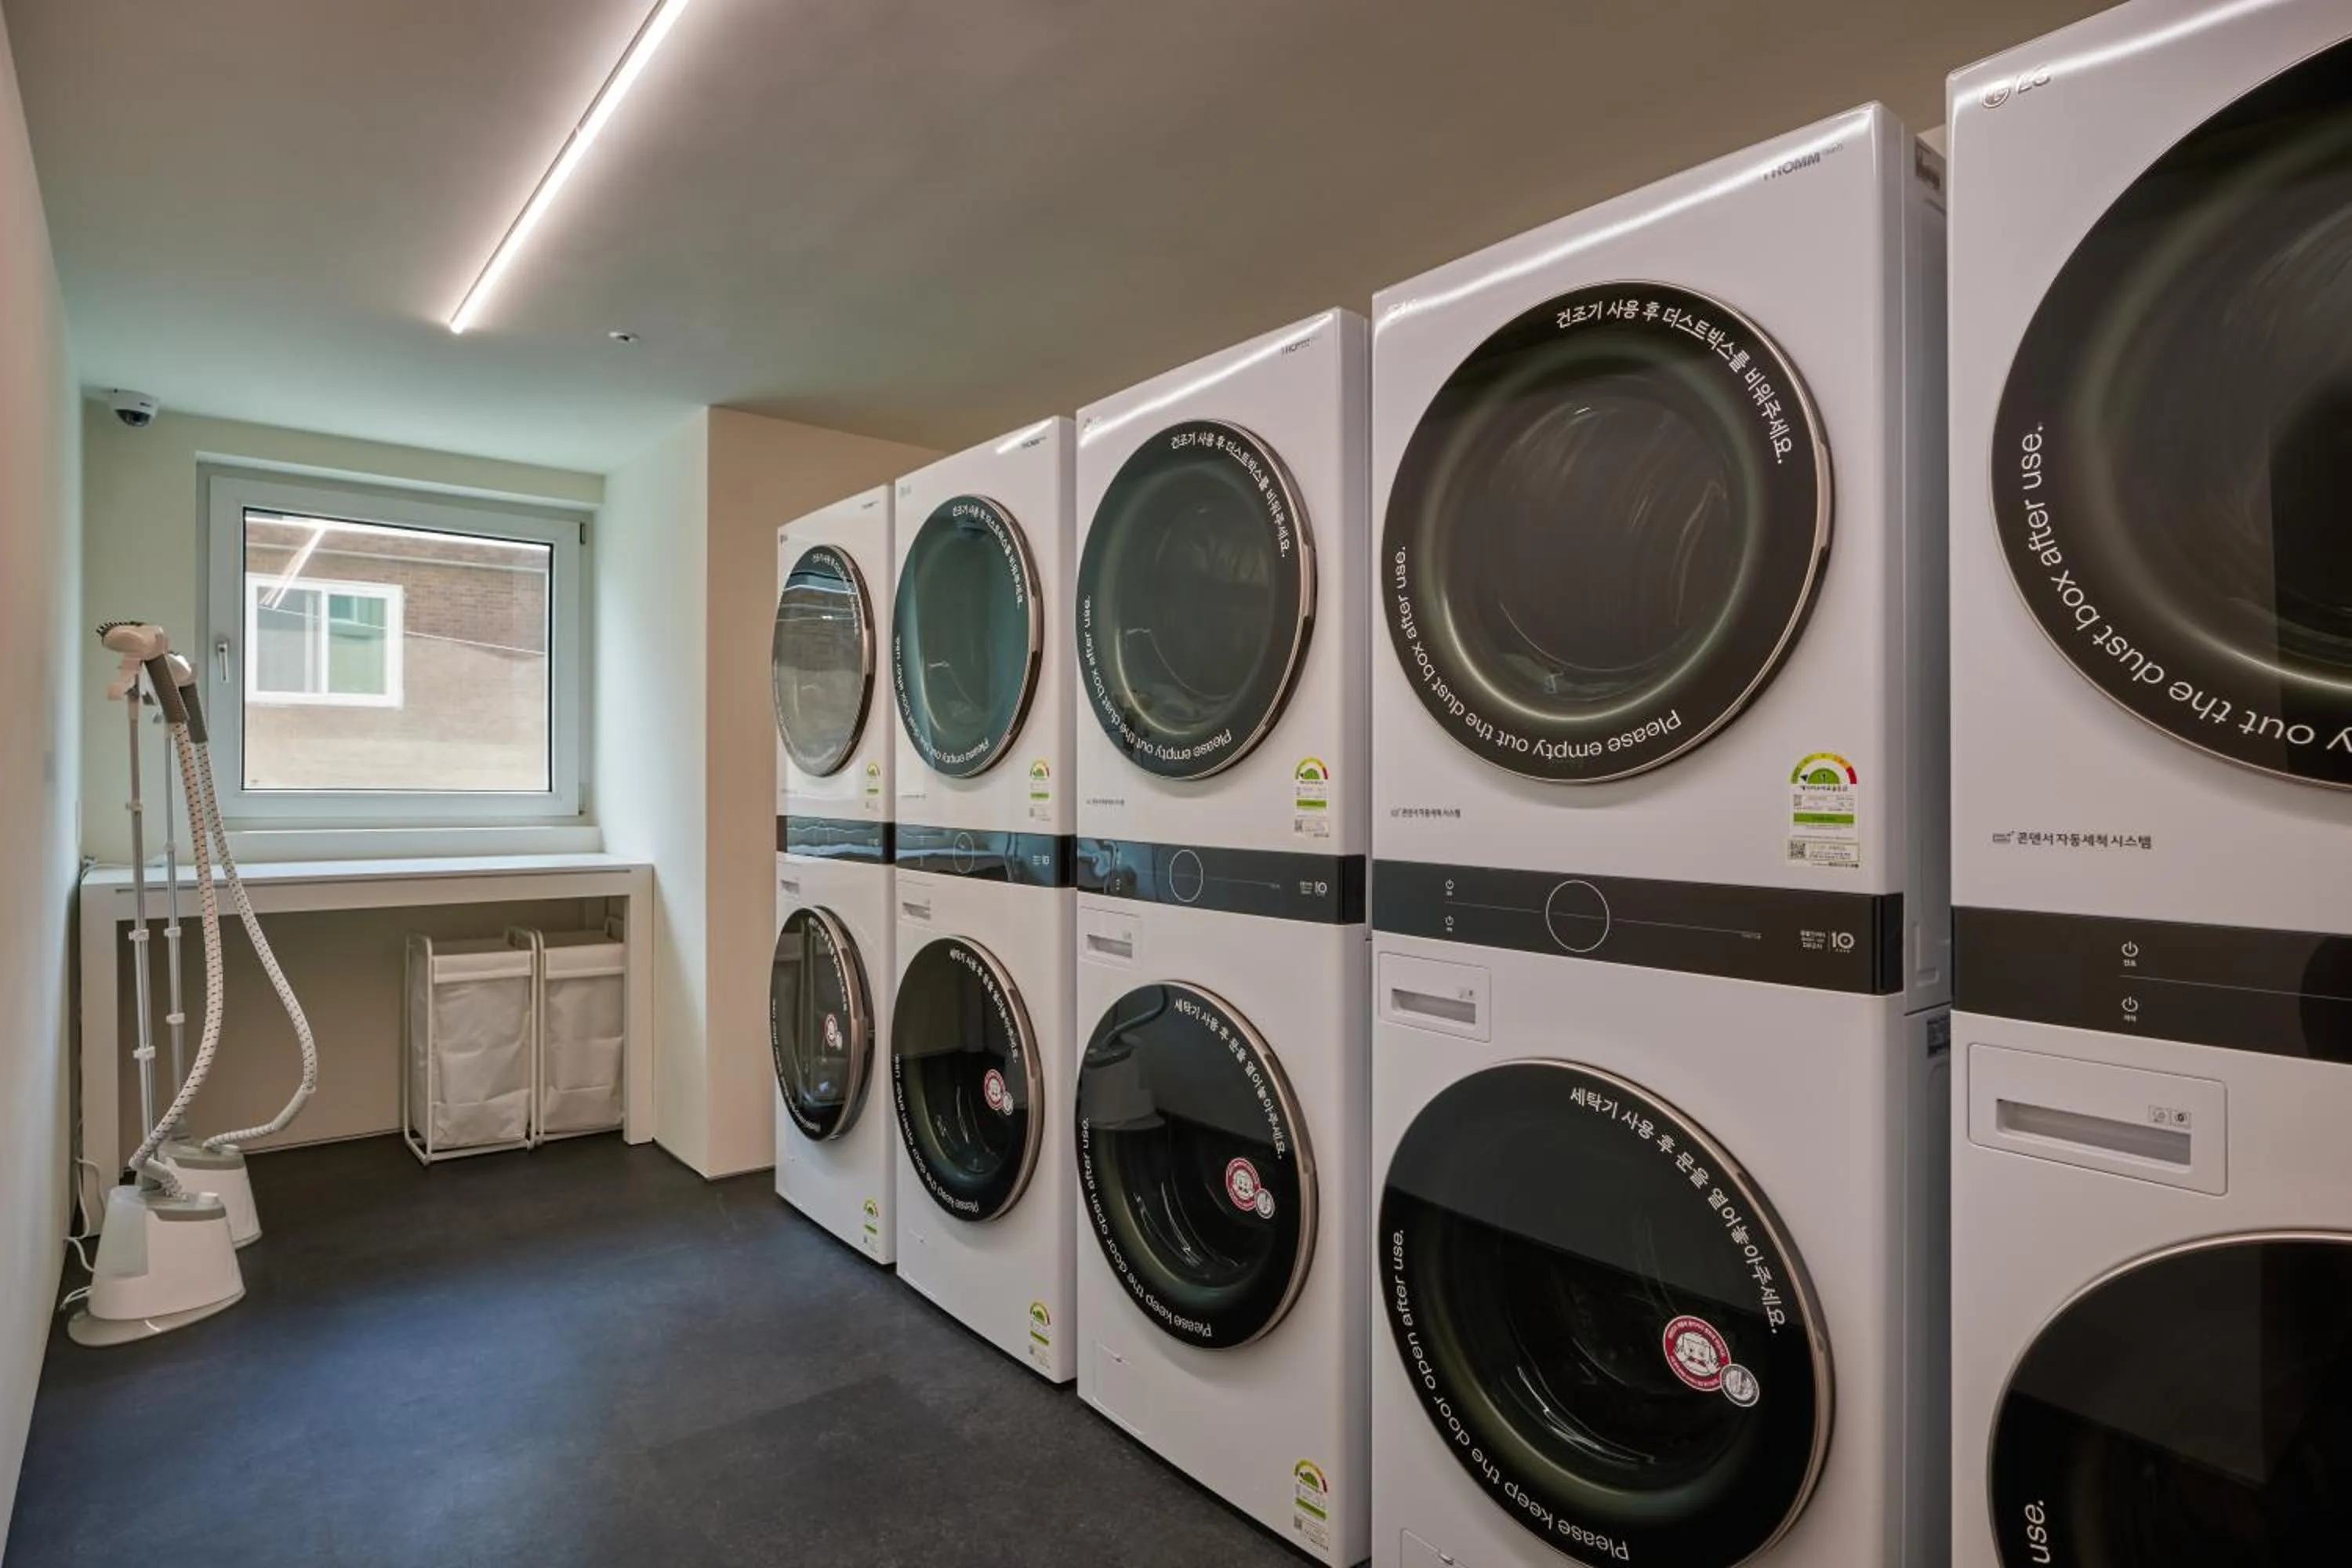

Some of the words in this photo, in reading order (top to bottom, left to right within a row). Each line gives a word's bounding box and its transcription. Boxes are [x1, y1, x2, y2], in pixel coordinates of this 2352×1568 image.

[1556, 301, 1602, 328] 건조기
[1606, 299, 1639, 319] 사용
[1642, 302, 1660, 321] 후
[1663, 307, 1751, 373] 더스트박스를
[1744, 368, 1791, 464] 비워주세요.
[2022, 422, 2043, 490] use.
[2025, 499, 2062, 566] after
[1395, 546, 1406, 590] use.
[1398, 595, 1417, 639] after
[2051, 571, 2100, 630] box
[1412, 641, 1436, 681] box
[2092, 626, 2164, 684] dust
[1431, 680, 1465, 717] dust
[2169, 681, 2232, 724] the
[1465, 712, 1493, 741] the
[1495, 731, 1528, 752] out
[1608, 709, 1682, 752] Please
[2238, 710, 2314, 744] out
[1533, 740, 1602, 760] empty
[2017, 832, 2053, 847] 콘덴서
[2111, 834, 2152, 850] 시스템
[1831, 931, 1855, 949] 10
[1570, 1087, 1619, 1120] 세탁기
[1621, 1110, 1654, 1139] 사용
[1657, 1134, 1676, 1154] 후
[1675, 1152, 1709, 1189] 문을
[1393, 1229, 1405, 1270] use.
[1394, 1276, 1413, 1327] after
[1406, 1333, 1436, 1390] open
[1433, 1396, 1471, 1447] door
[1472, 1447, 1501, 1485] the
[1504, 1481, 1553, 1530] keep
[1557, 1519, 1630, 1561] Please
[2024, 1499, 2051, 1564] use.
